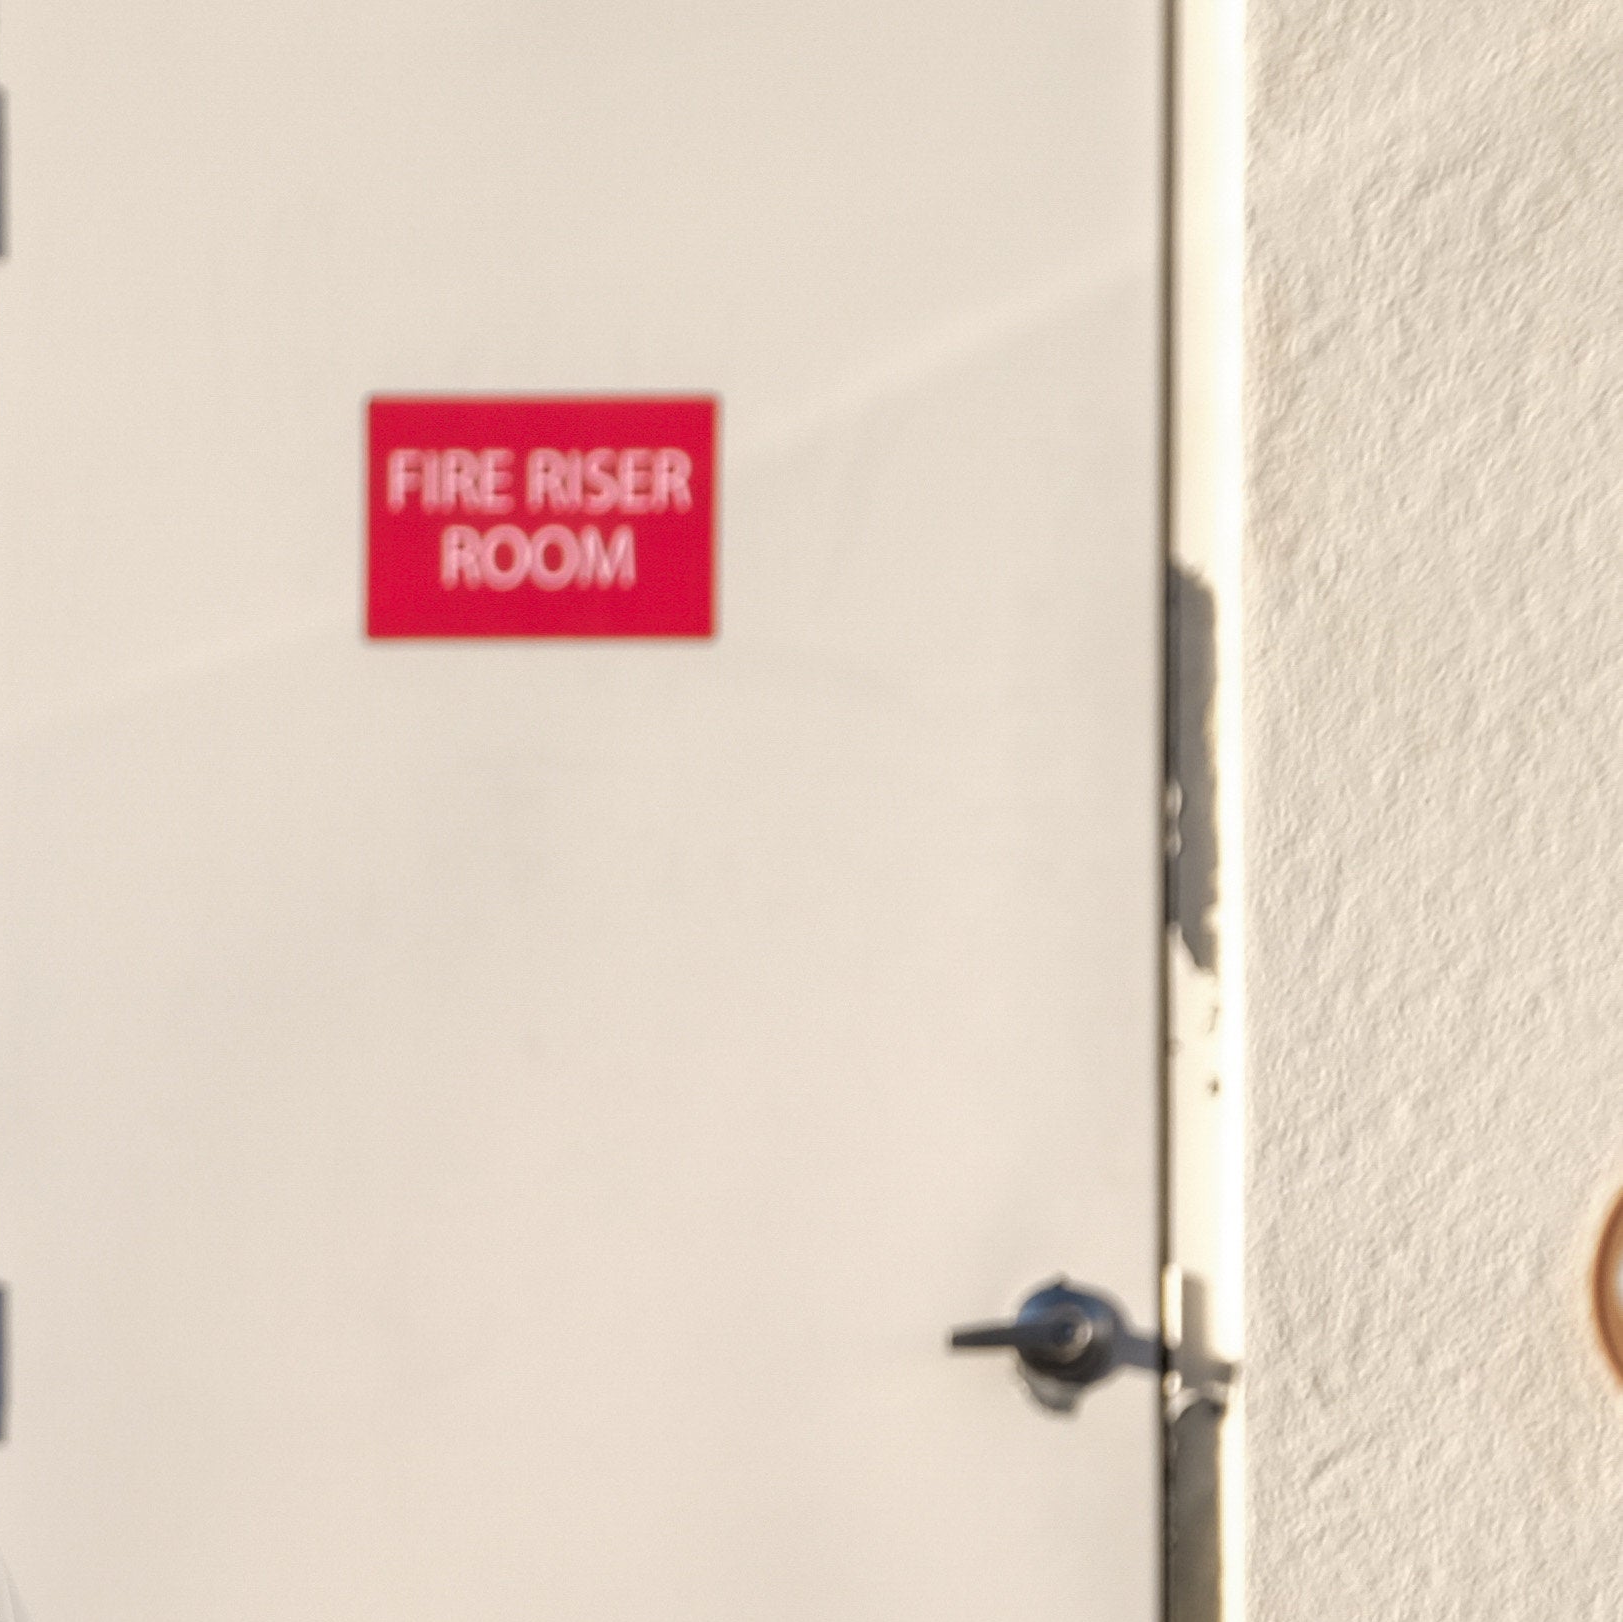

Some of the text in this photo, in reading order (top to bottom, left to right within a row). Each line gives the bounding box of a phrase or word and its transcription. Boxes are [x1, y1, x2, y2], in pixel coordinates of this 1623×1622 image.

[387, 447, 693, 513] FIRE RISER
[440, 523, 636, 591] ROOM
